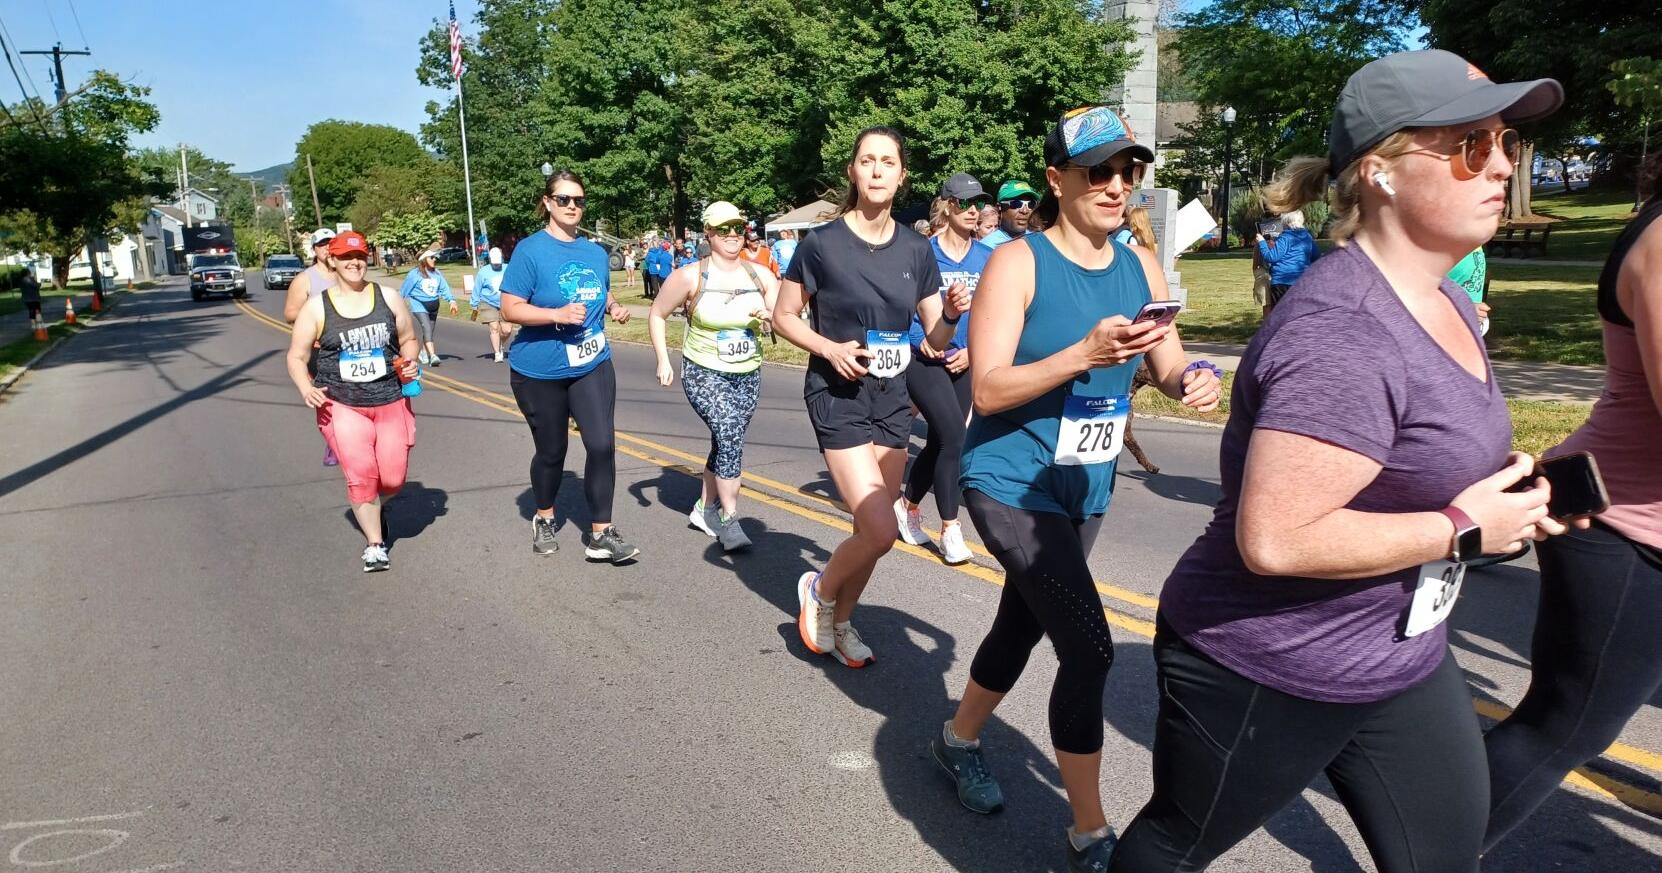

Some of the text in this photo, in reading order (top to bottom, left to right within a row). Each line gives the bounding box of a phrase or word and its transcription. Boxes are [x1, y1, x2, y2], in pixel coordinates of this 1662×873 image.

[577, 339, 598, 359] 289
[727, 340, 749, 356] 349
[877, 348, 901, 370] 364
[350, 361, 376, 377] 254
[1086, 398, 1117, 407] FALCON
[1077, 422, 1114, 452] 278
